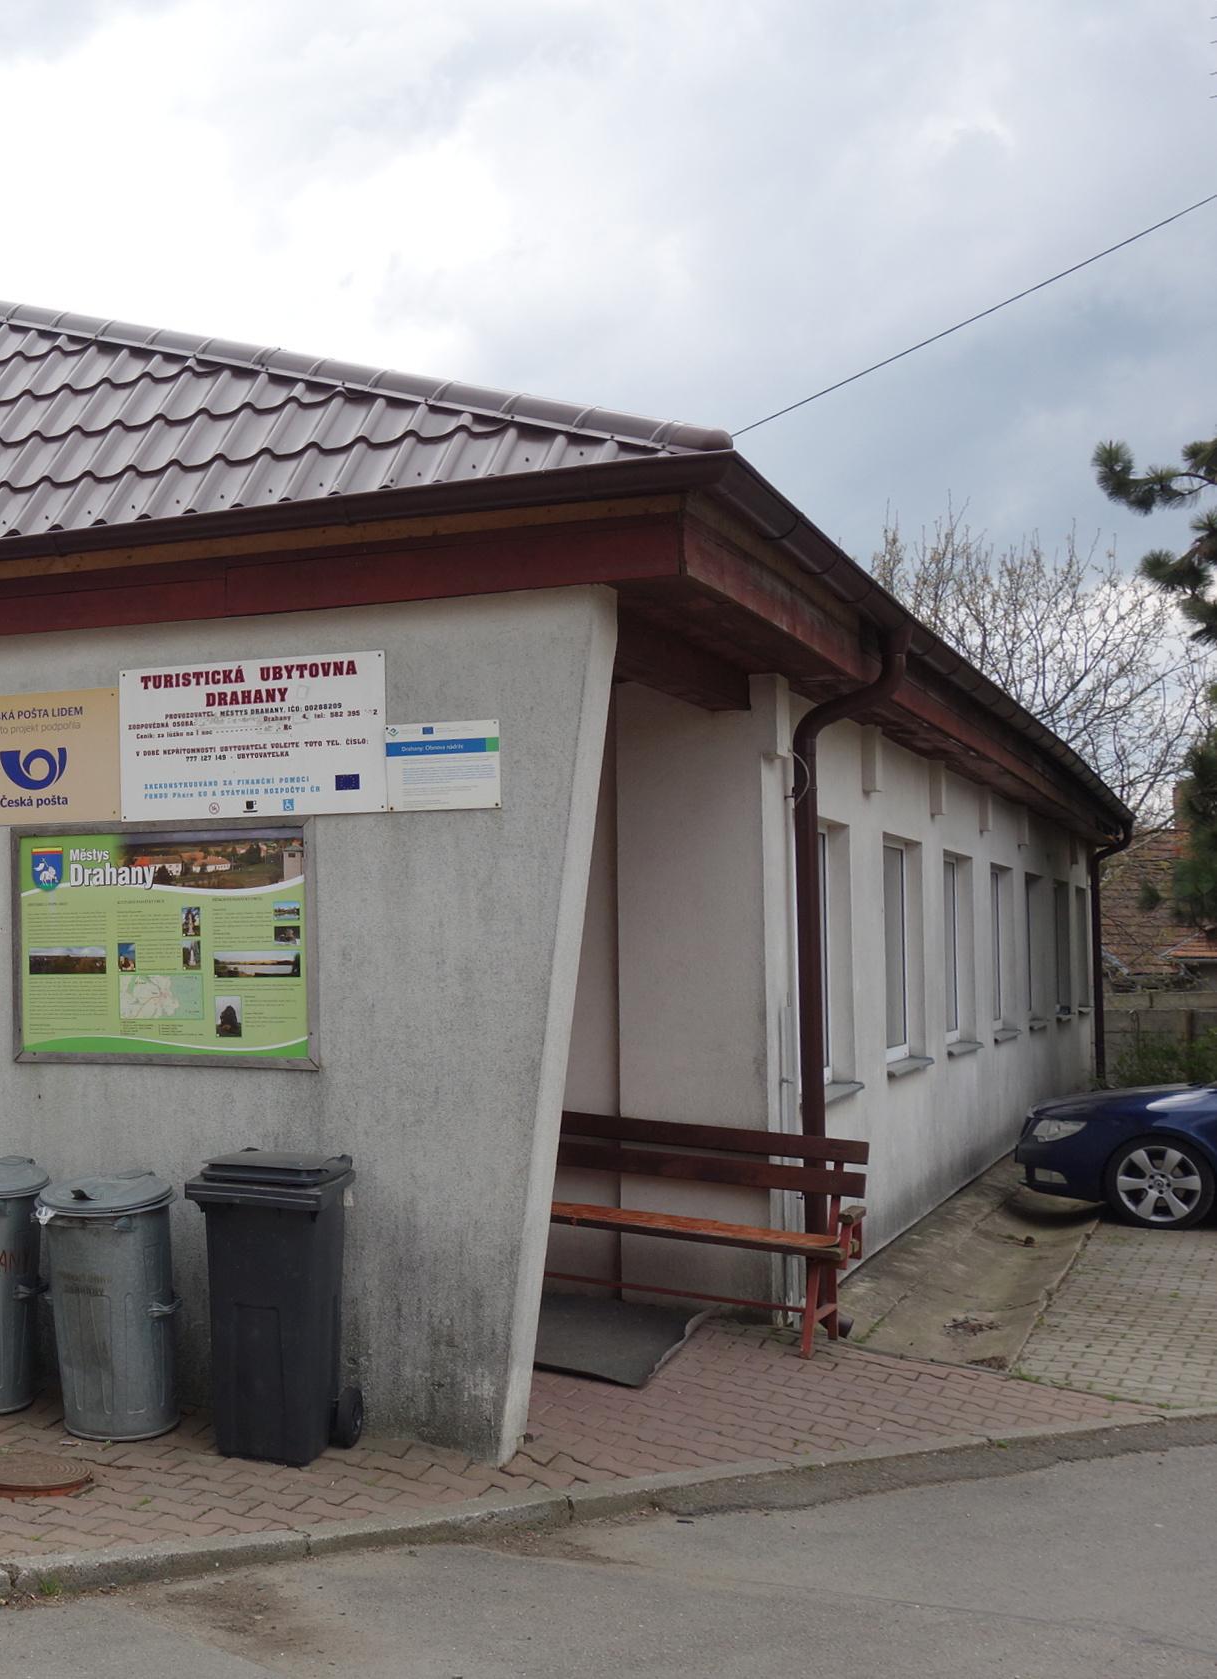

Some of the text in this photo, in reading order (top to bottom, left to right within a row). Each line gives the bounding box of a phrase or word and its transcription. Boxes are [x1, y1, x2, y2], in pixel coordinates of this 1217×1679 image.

[140, 660, 358, 690] TURISTICKÁ UBYTOVNA
[205, 687, 289, 708] DRAHANY
[17, 707, 50, 719] POŠTA
[52, 705, 84, 718] LIDEM
[304, 702, 343, 712] 00288209
[172, 720, 197, 728] OSOBA:
[263, 714, 291, 722] Drahany
[314, 712, 326, 720] tel:
[347, 709, 361, 717] 395
[10, 721, 39, 736] projekt
[41, 719, 82, 734] podpořila
[219, 743, 268, 752] UBYTOVATELE
[270, 741, 300, 749] VOLEJTE
[304, 740, 323, 748] TOTO
[237, 751, 290, 760] UBYTOVATELKA
[0, 794, 69, 809] Česká pošta
[69, 847, 110, 863] Městys
[69, 863, 155, 890] Drahany
